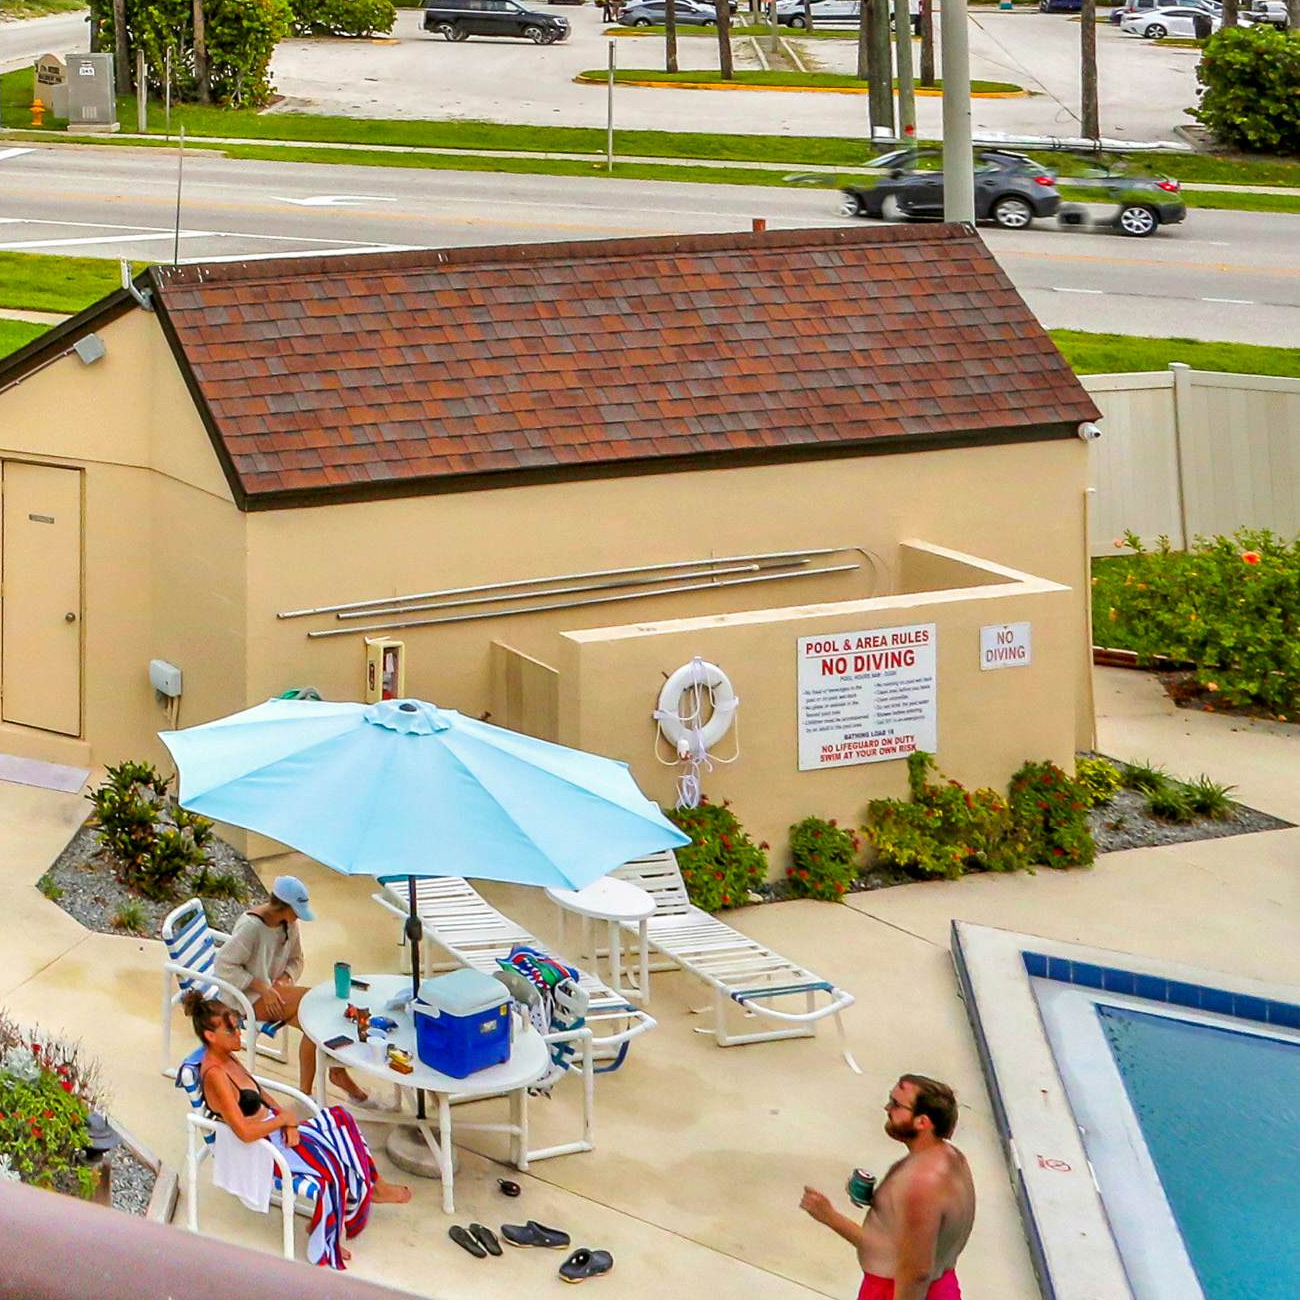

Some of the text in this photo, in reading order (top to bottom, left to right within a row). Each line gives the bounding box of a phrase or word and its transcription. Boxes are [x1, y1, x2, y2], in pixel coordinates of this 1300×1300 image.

[806, 630, 929, 654] POOL & AREA RULES
[997, 630, 1013, 644] NO
[822, 650, 914, 675] NO DIVING
[986, 645, 1025, 662] DIVING
[820, 744, 917, 762] SWIM AT YOUR OWN RISK
[822, 735, 915, 753] NO LIFEGUARD ON DUTY
